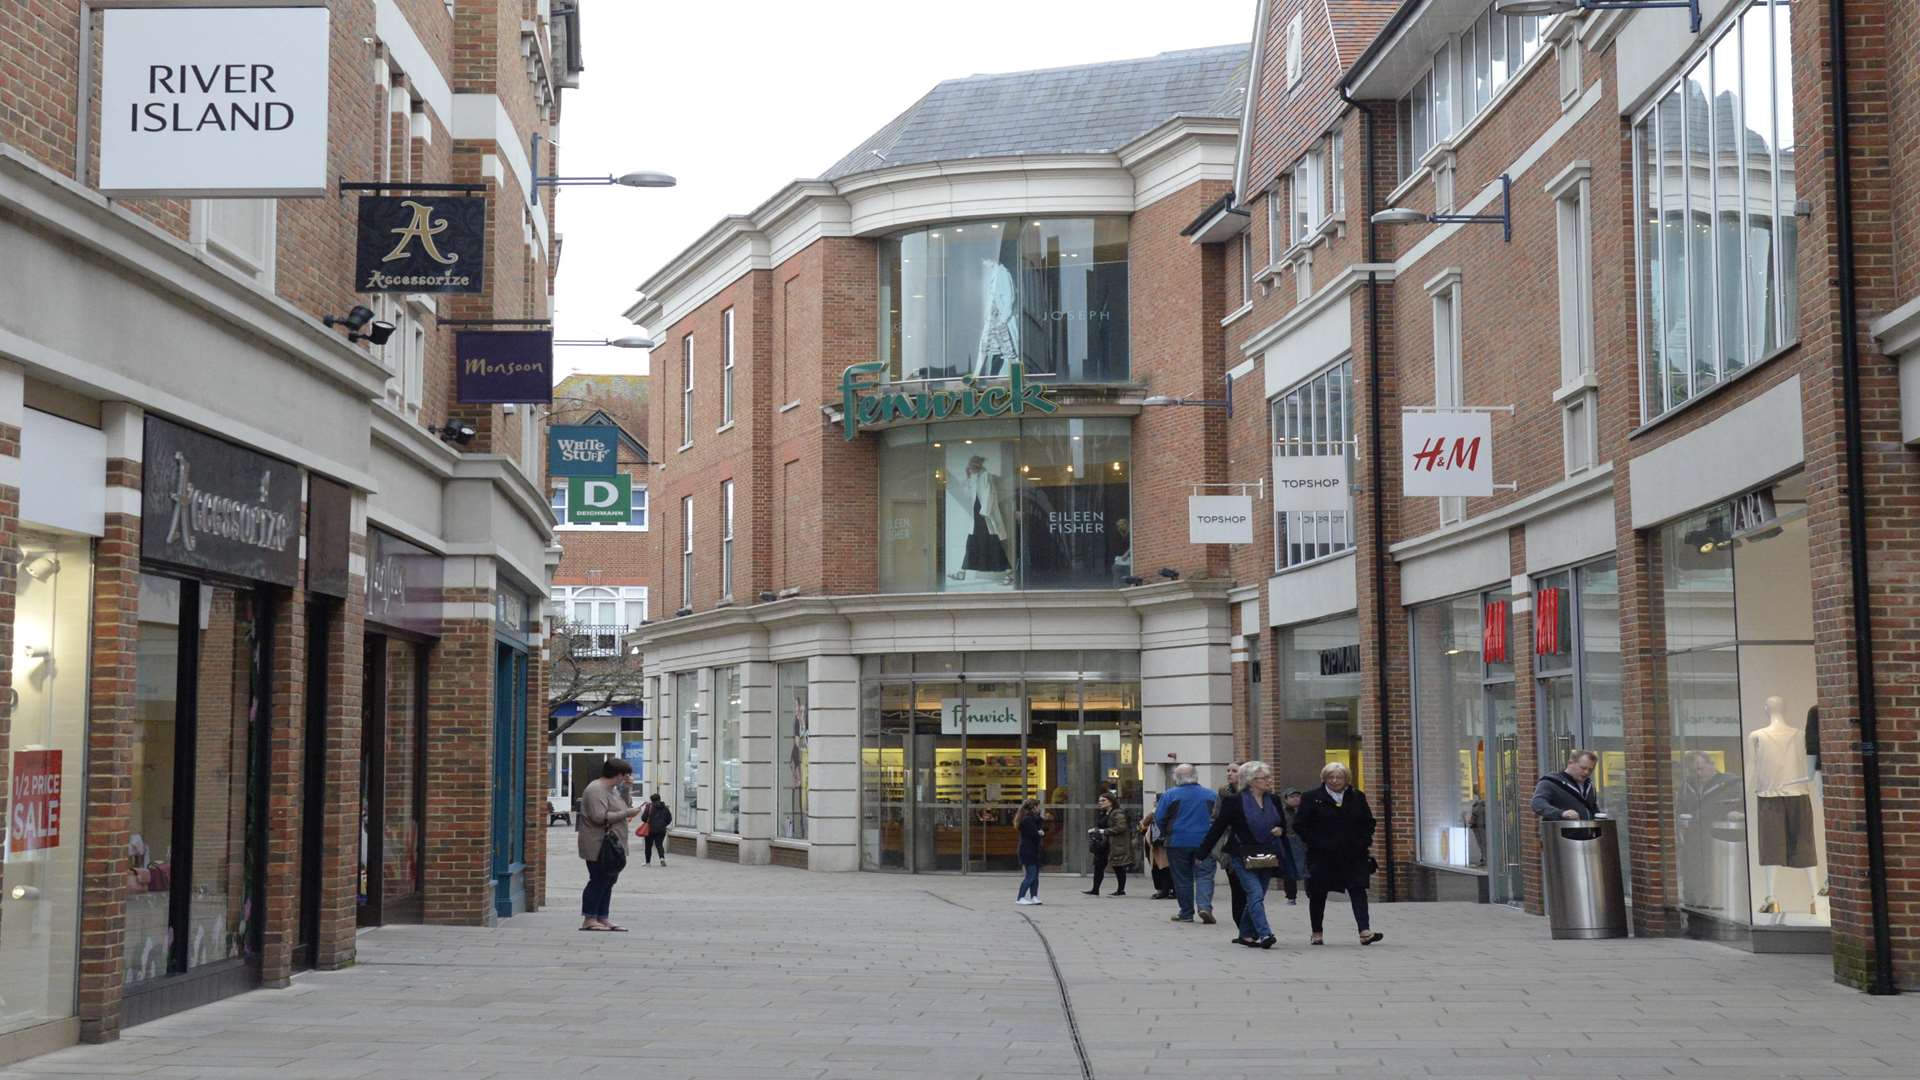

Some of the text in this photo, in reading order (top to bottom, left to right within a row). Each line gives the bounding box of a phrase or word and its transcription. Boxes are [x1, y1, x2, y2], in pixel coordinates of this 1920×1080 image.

[149, 64, 276, 94] RIVER
[130, 102, 294, 132] ISLAND
[381, 200, 459, 264] A
[365, 269, 470, 288] Accessorize
[1043, 311, 1110, 321] JOSEPH
[465, 357, 543, 376] Monsoon
[837, 361, 1059, 442] Fenwick
[1413, 436, 1481, 472] H&M
[583, 481, 619, 508] D
[1281, 479, 1340, 489] TOPSHOP
[1049, 511, 1104, 522] EILEEN
[1197, 515, 1247, 525] TOPSHOP
[1049, 523, 1105, 534] FISHER
[31, 774, 60, 795] PRICE
[14, 800, 60, 840] SALE
